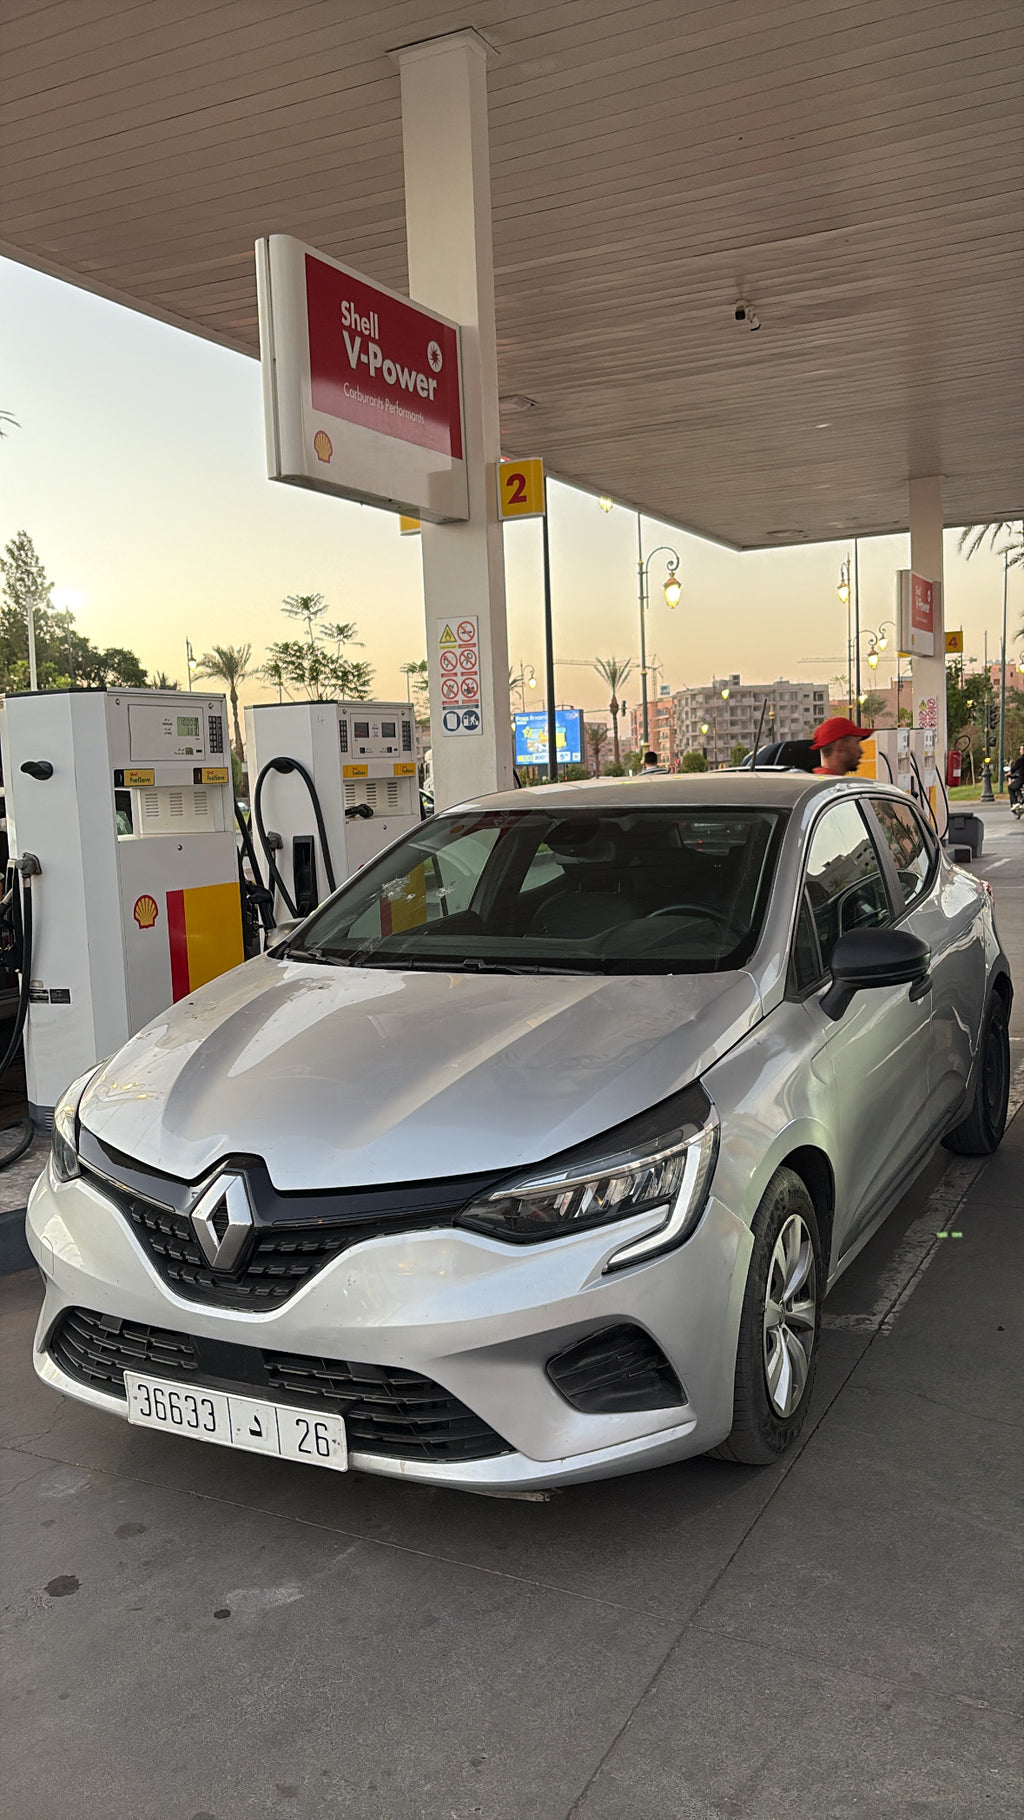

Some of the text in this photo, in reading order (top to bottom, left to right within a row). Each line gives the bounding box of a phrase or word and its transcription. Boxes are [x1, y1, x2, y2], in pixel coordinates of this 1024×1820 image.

[341, 300, 379, 340] Shell
[342, 330, 438, 401] V-Power
[343, 382, 425, 424] Carburants Performants
[506, 473, 527, 505] 2
[948, 636, 959, 648] 4
[137, 1383, 217, 1433] 36633
[295, 1418, 331, 1458] 26
